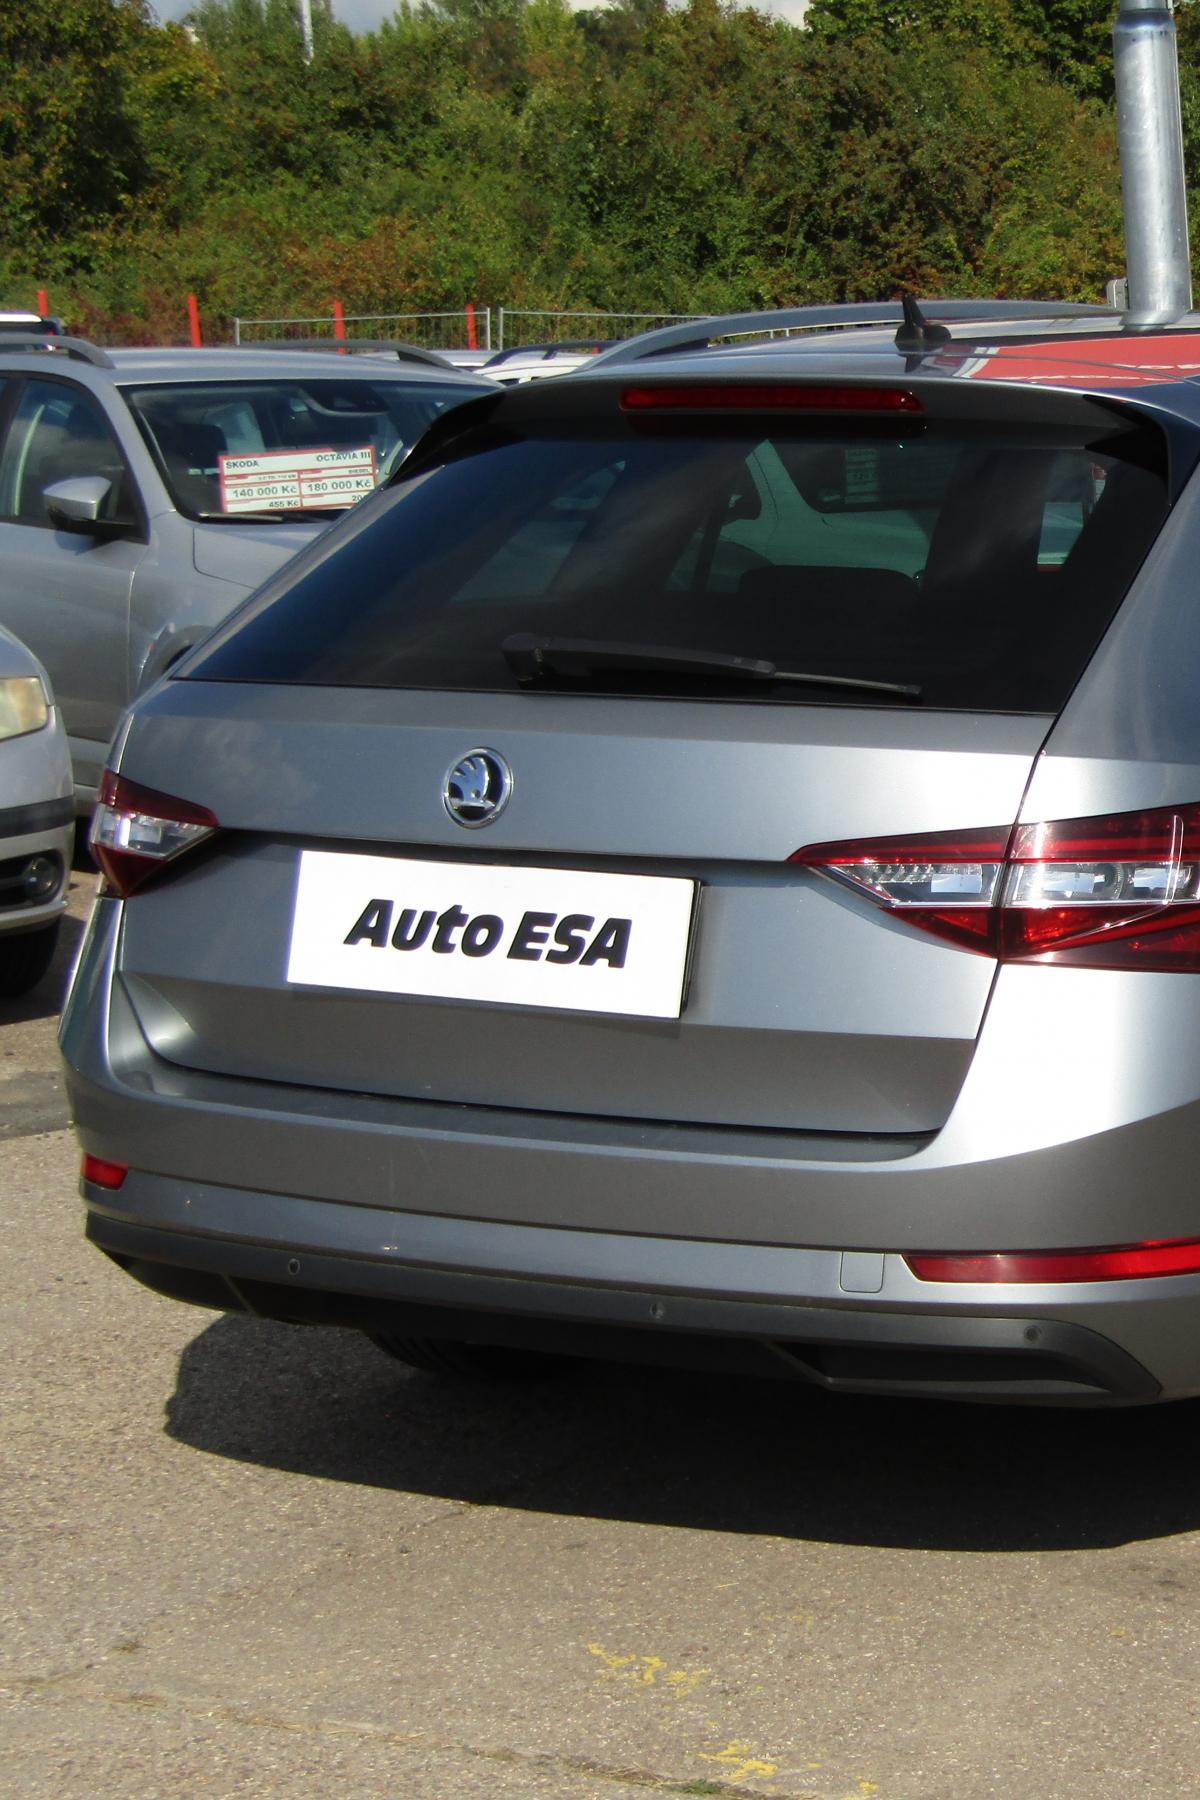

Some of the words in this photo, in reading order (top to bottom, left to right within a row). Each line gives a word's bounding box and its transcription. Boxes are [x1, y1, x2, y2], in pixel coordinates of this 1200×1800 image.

[316, 451, 358, 462] OCTAVIA
[233, 487, 254, 498] 140
[257, 486, 278, 496] 000
[281, 484, 297, 494] Kč
[308, 482, 328, 492] 180
[331, 481, 353, 490] 000
[356, 479, 371, 488] Kč
[343, 898, 504, 958] Auto
[506, 910, 632, 968] ESA
